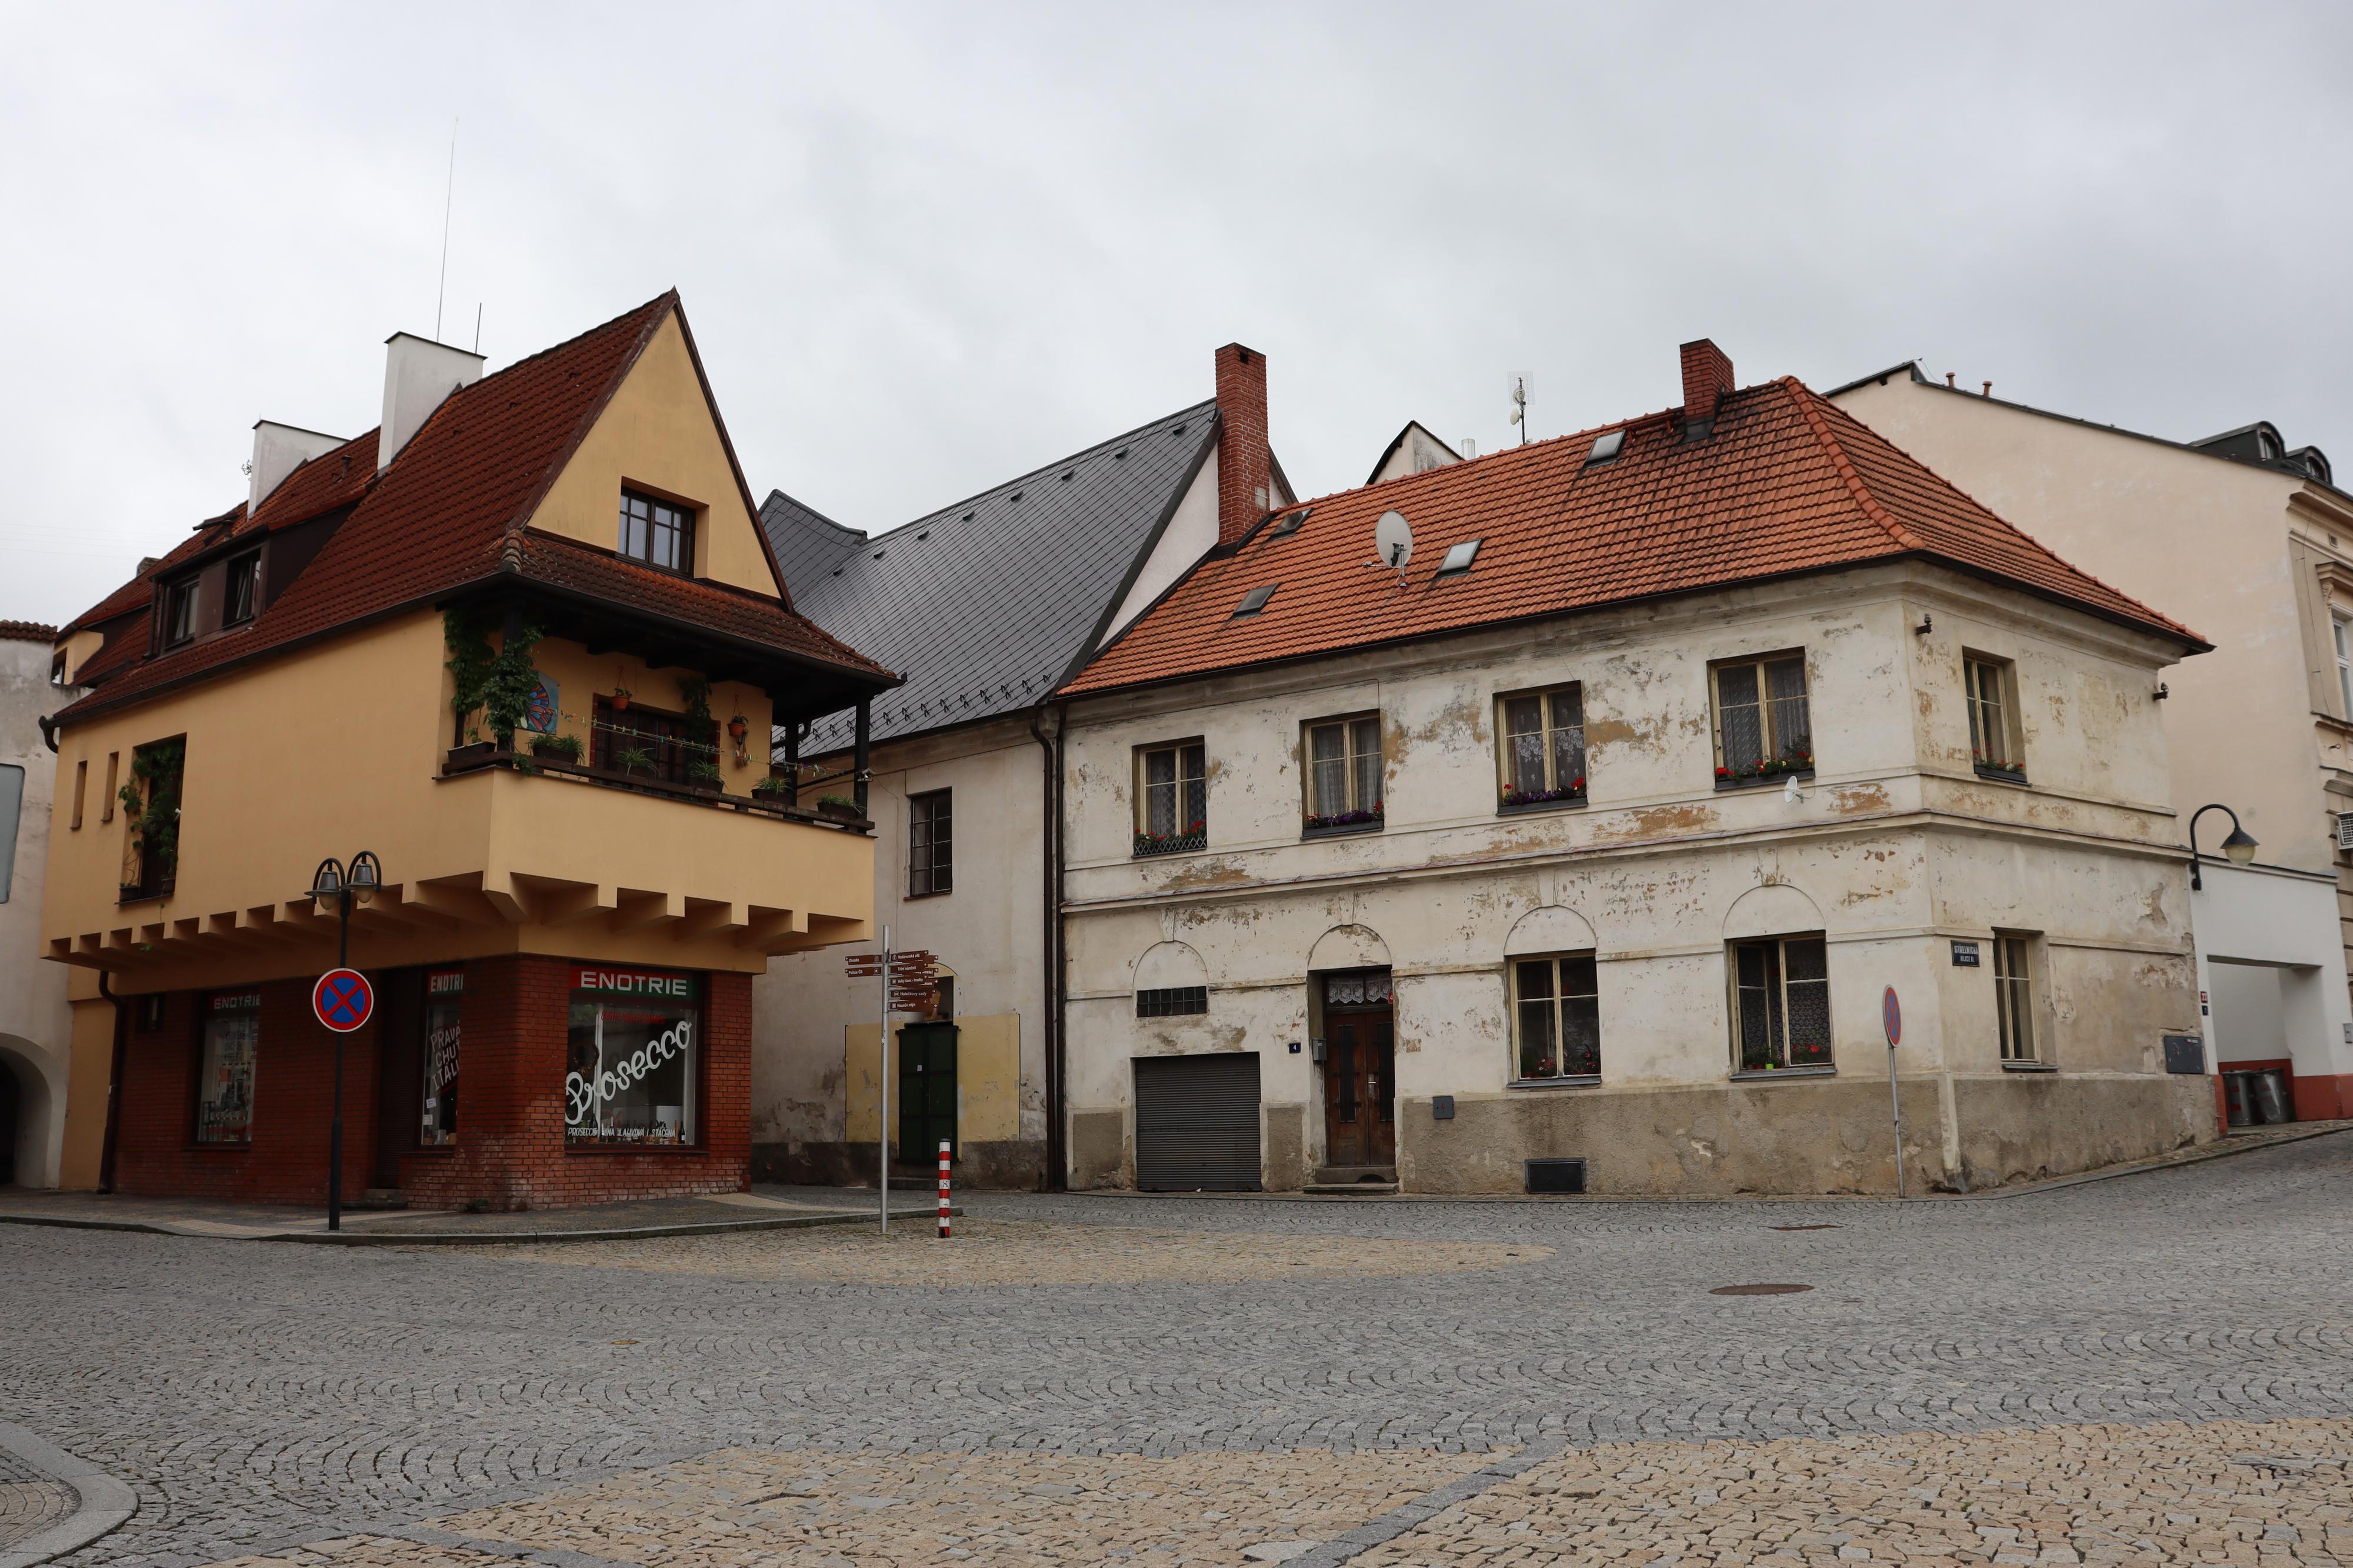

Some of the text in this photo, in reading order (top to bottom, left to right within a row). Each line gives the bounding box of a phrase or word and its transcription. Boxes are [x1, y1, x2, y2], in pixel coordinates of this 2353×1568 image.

[431, 973, 464, 992] ENOTRI
[581, 971, 687, 996] ENOTRIE
[214, 995, 261, 1009] ENOTRIE
[431, 1019, 461, 1052] PRAVÁ
[565, 1020, 692, 1125] Prosecco
[568, 1127, 598, 1137] PROSECCO
